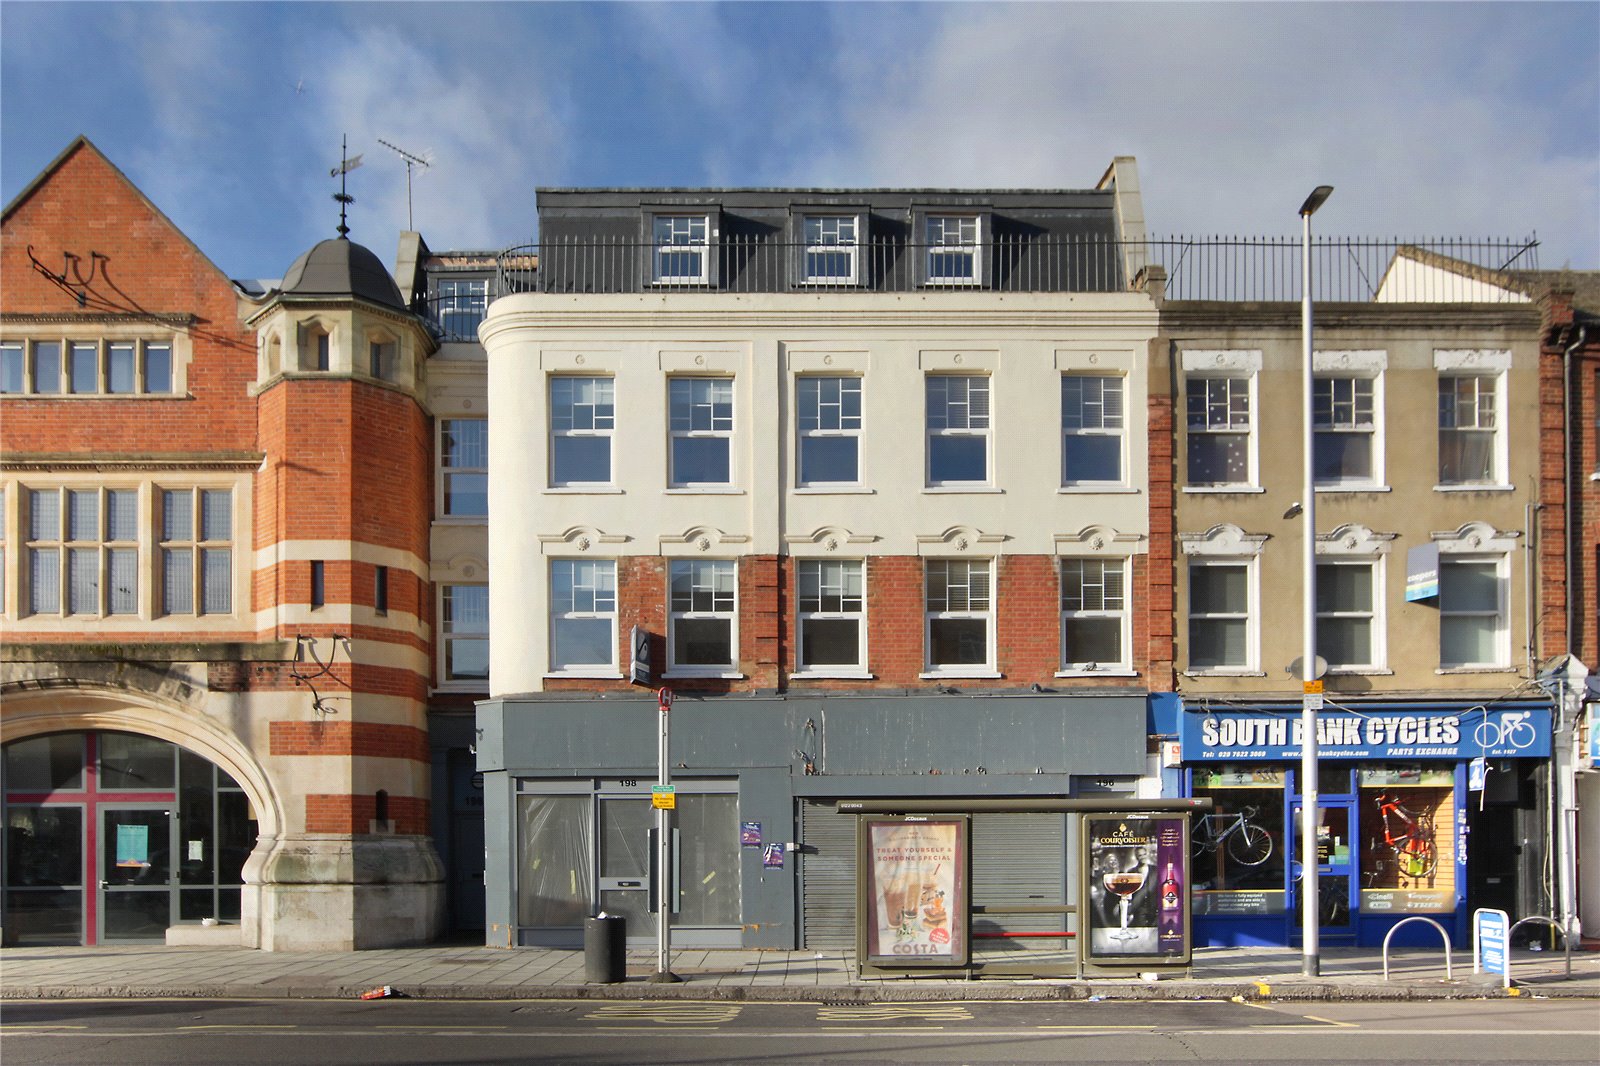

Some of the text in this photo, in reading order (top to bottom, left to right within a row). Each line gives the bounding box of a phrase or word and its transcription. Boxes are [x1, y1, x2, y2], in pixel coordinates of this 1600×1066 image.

[1407, 570, 1437, 582] coopers
[1202, 718, 1287, 746] SOUTH
[1366, 716, 1460, 745] CYCLES
[1387, 747, 1458, 756] PARTS EXCHANGE
[620, 779, 637, 787] 198
[1100, 837, 1147, 845] COURVOISIER
[892, 944, 938, 955] COSTA
